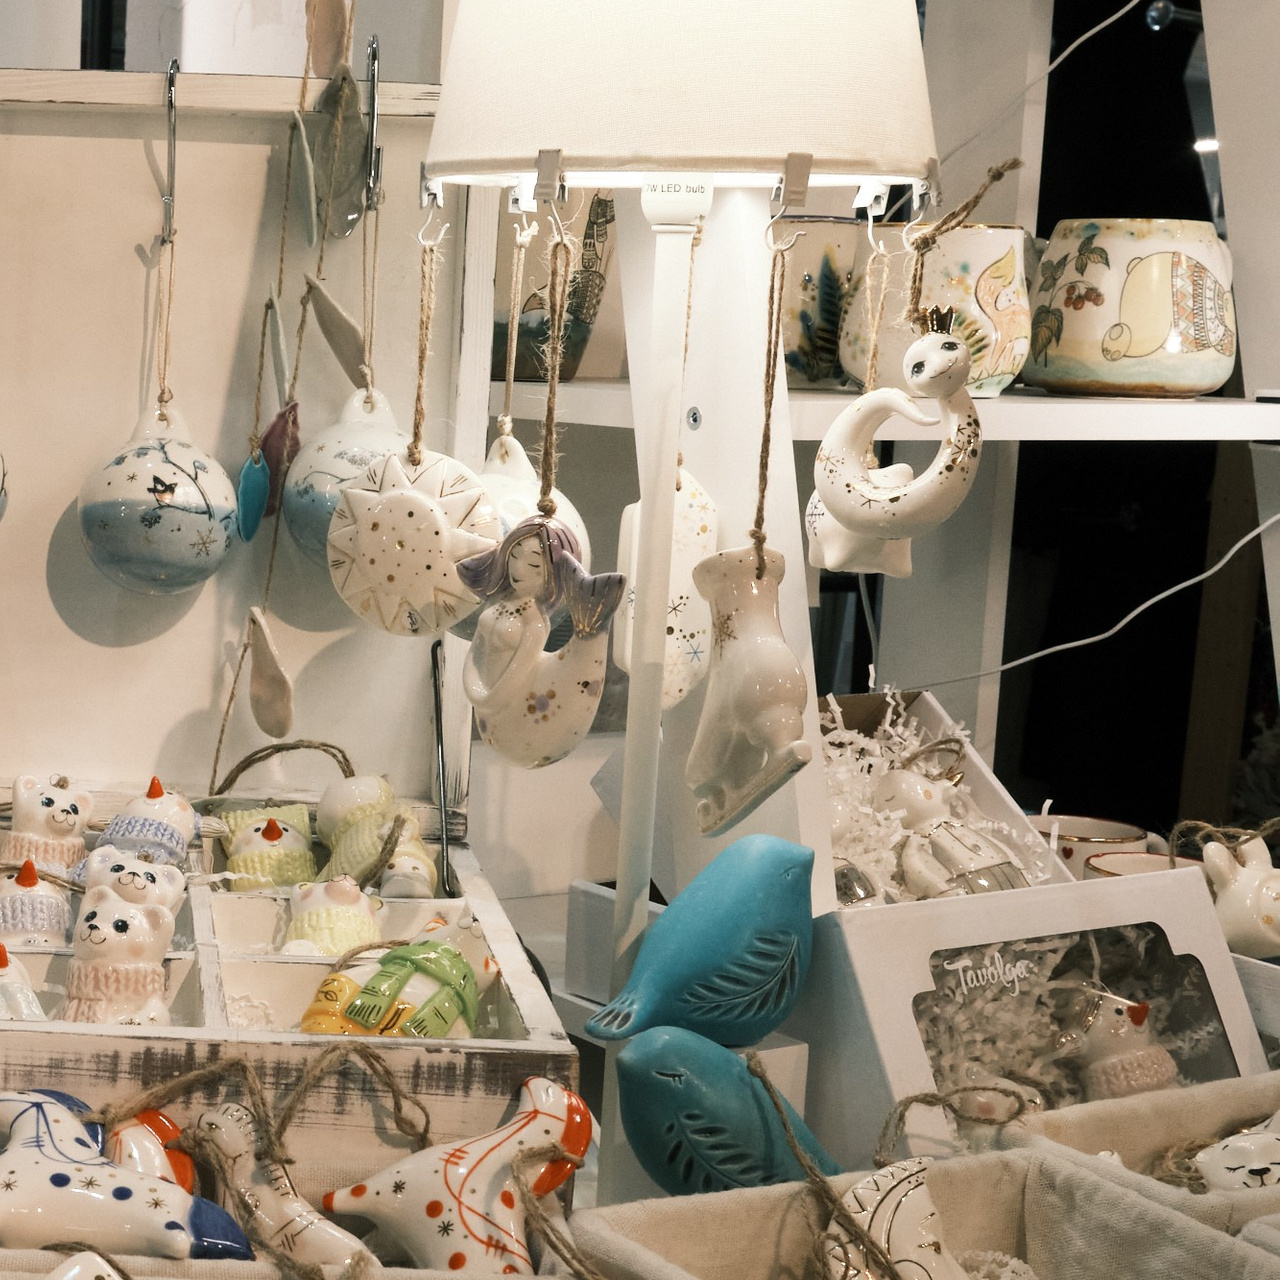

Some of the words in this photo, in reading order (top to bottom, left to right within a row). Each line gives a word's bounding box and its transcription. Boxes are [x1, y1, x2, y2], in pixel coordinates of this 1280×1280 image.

[661, 183, 682, 193] LED
[685, 184, 705, 194] bulb
[943, 951, 1030, 997] Tavolga
